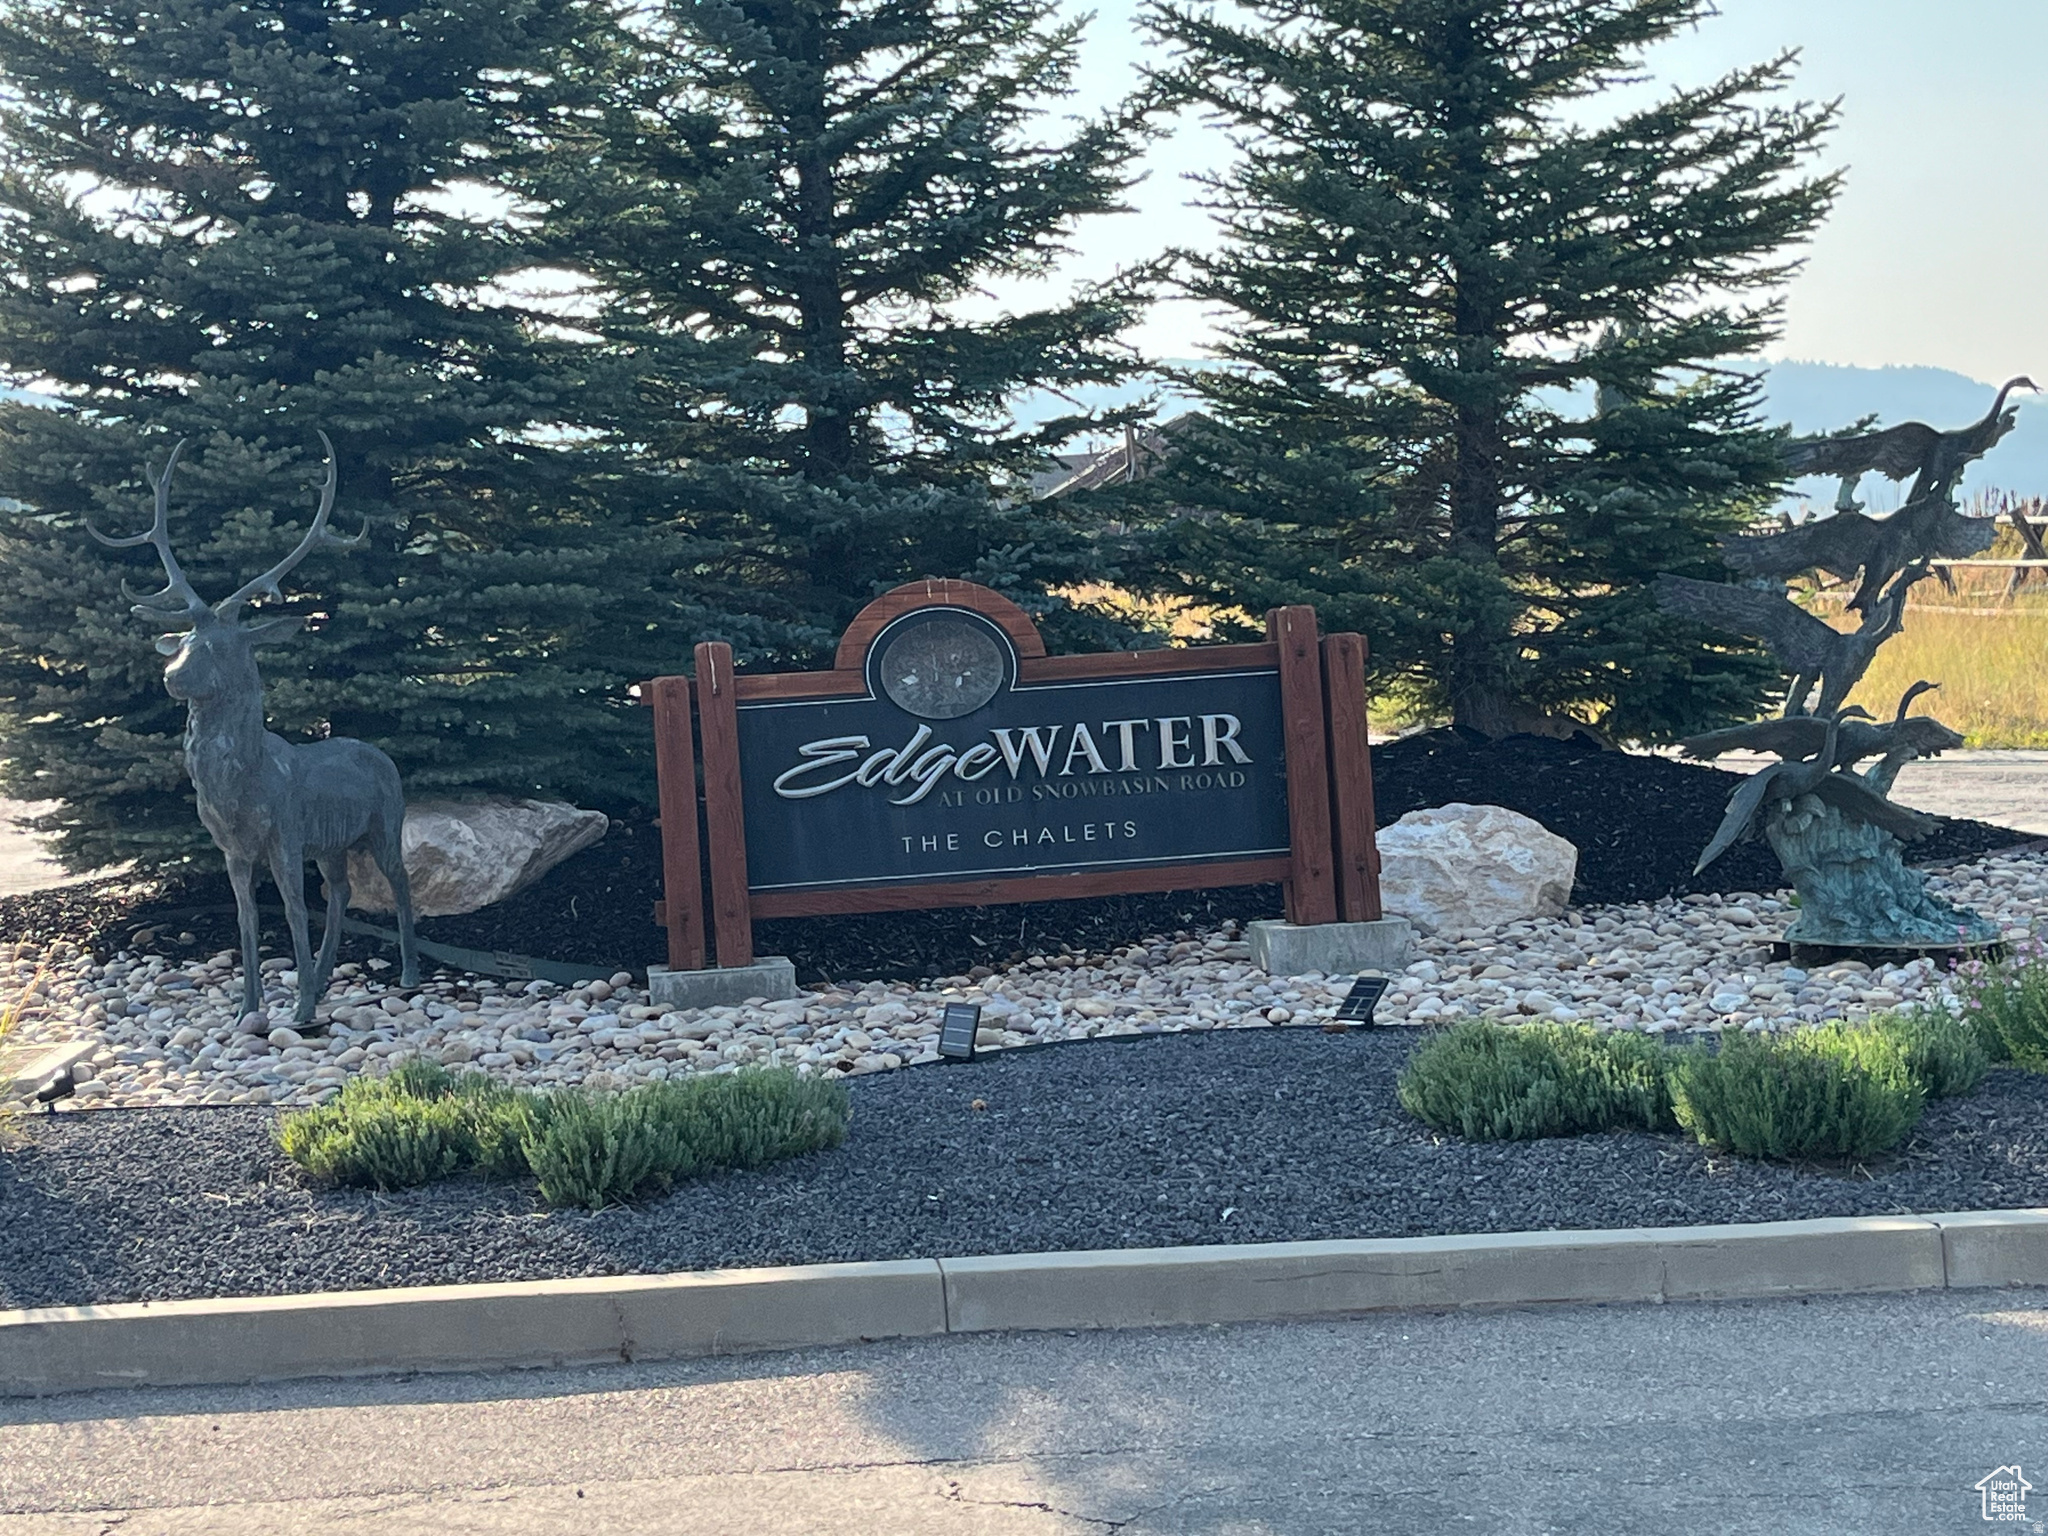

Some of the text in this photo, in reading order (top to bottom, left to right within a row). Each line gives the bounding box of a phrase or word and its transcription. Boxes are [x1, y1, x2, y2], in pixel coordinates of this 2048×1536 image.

[938, 790, 966, 807] AT
[1032, 775, 1170, 801] SNOWBASIN
[1181, 771, 1246, 791] ROAD
[901, 820, 1138, 853] THE CHALETS
